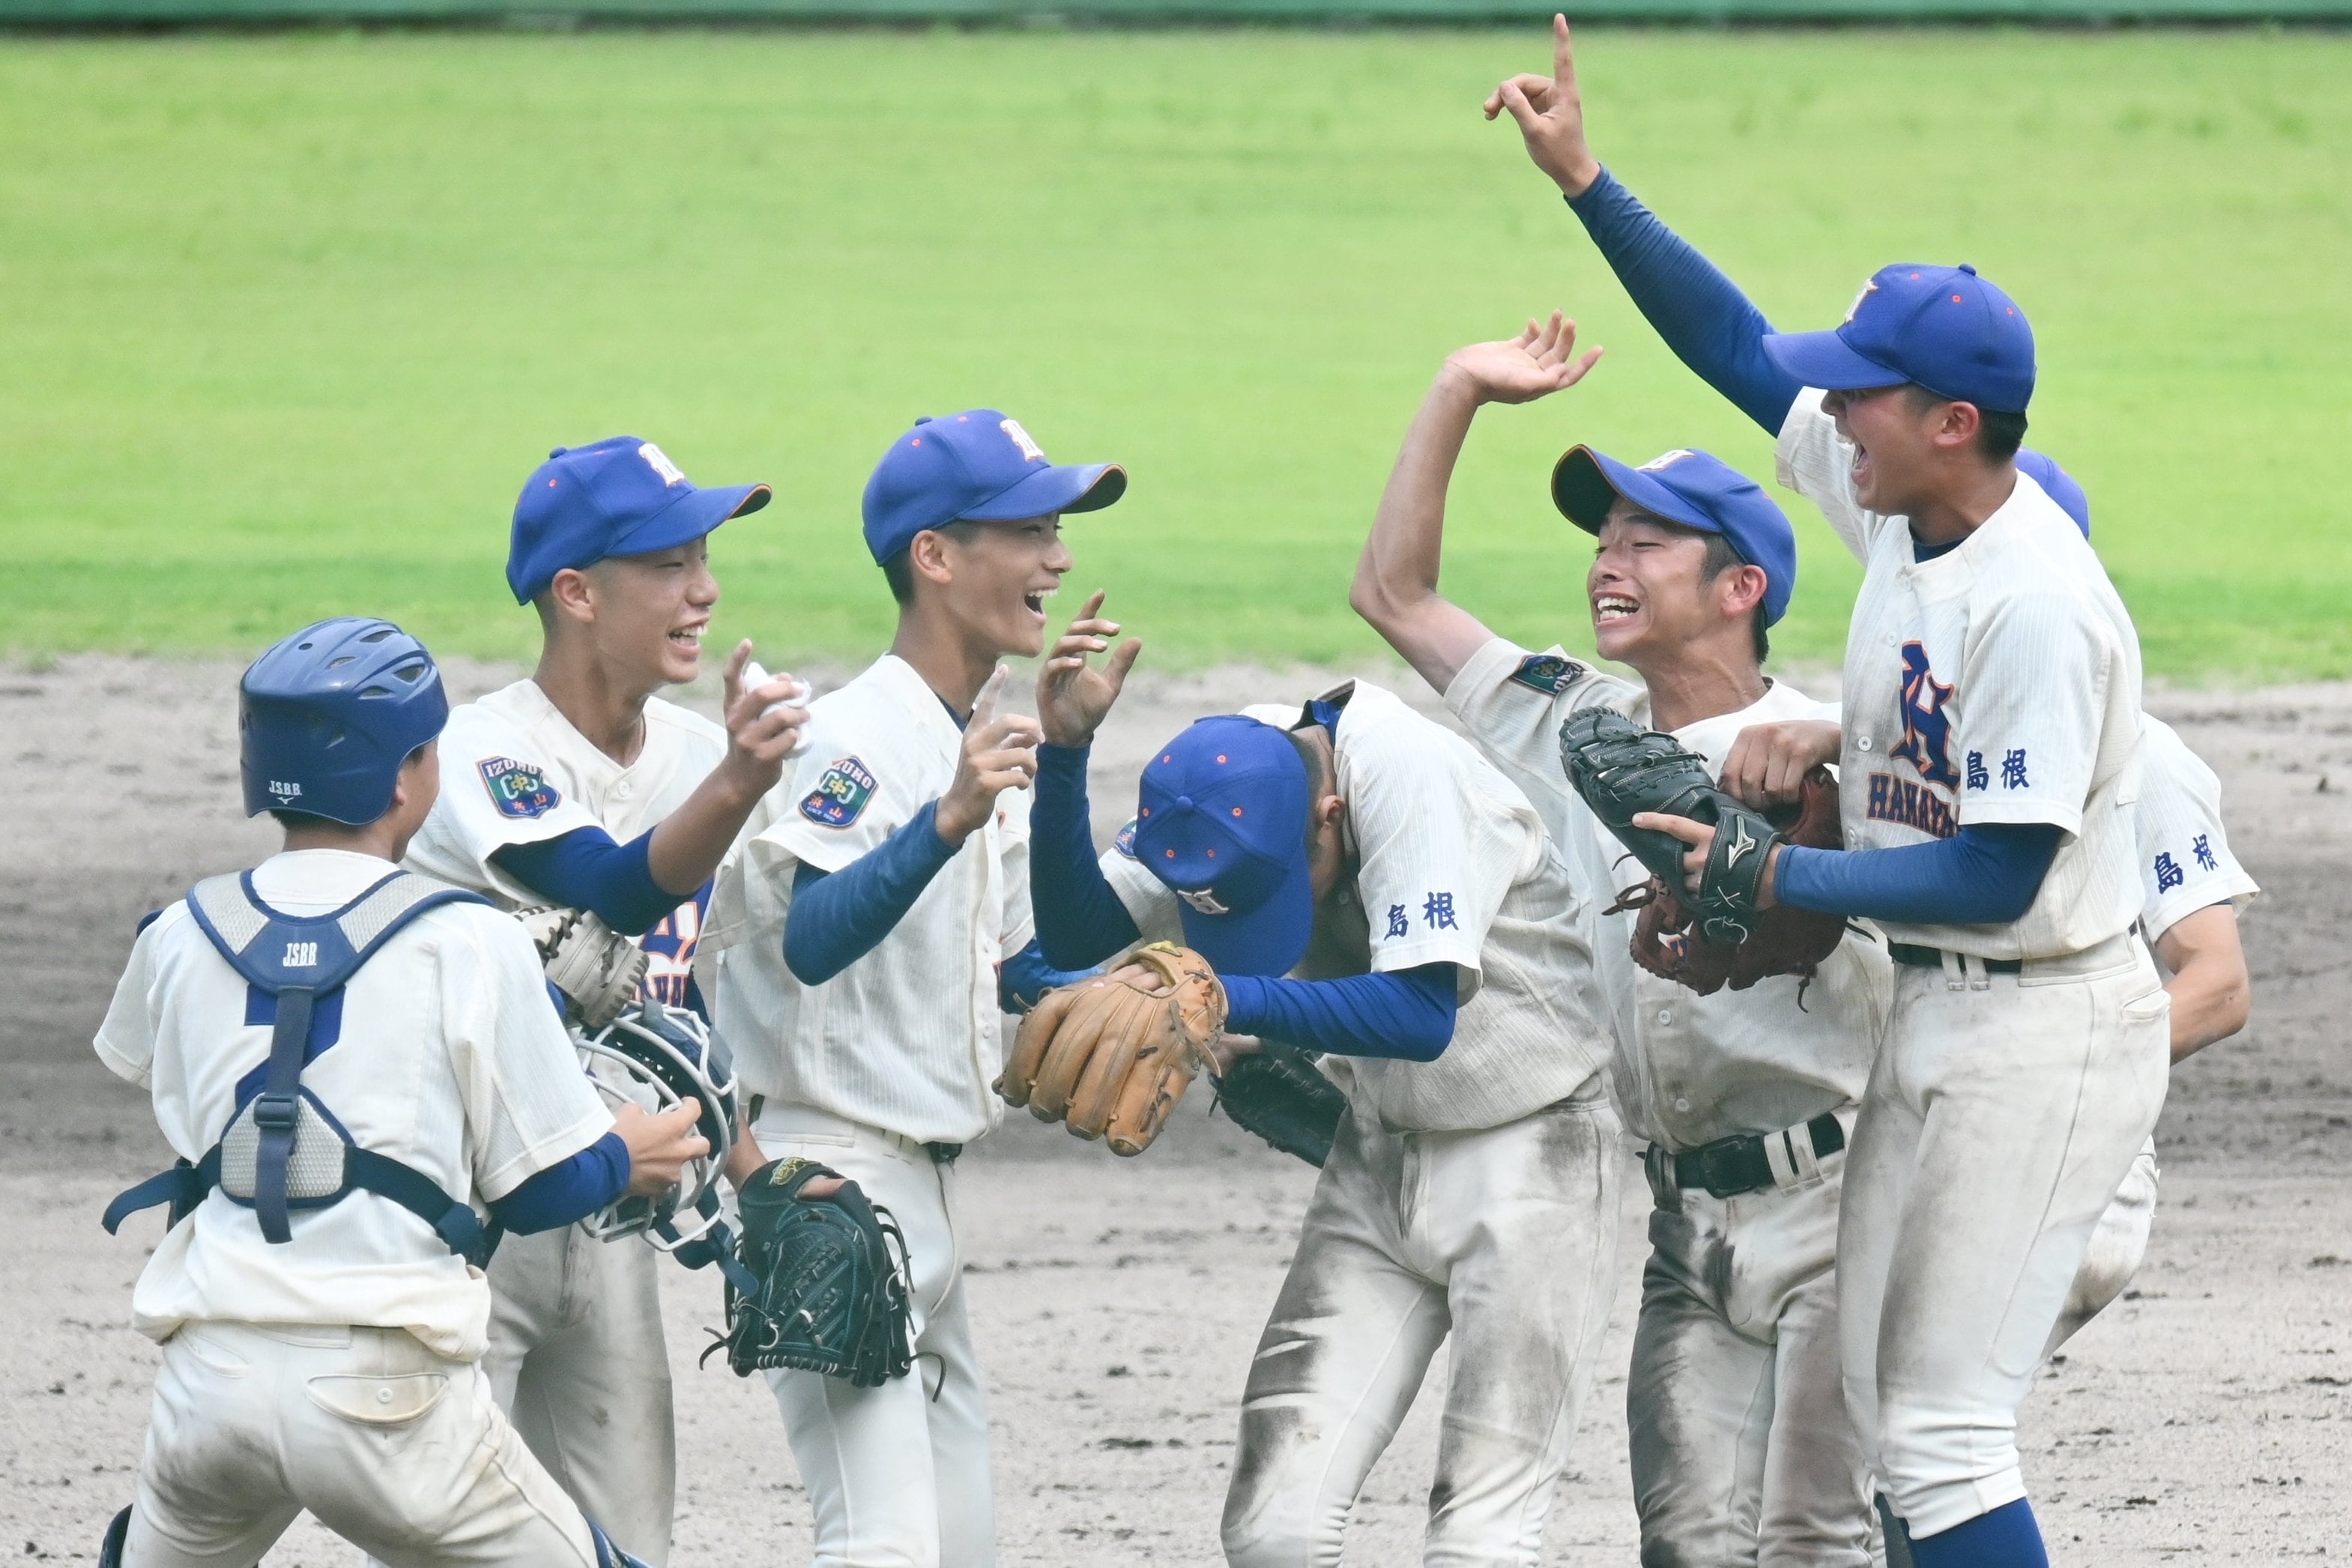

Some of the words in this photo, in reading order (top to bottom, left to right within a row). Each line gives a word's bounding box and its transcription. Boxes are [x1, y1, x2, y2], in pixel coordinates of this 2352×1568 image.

[1966, 748, 2030, 791] 島根
[2153, 833, 2219, 895] 島根
[1383, 892, 1460, 941] 島根
